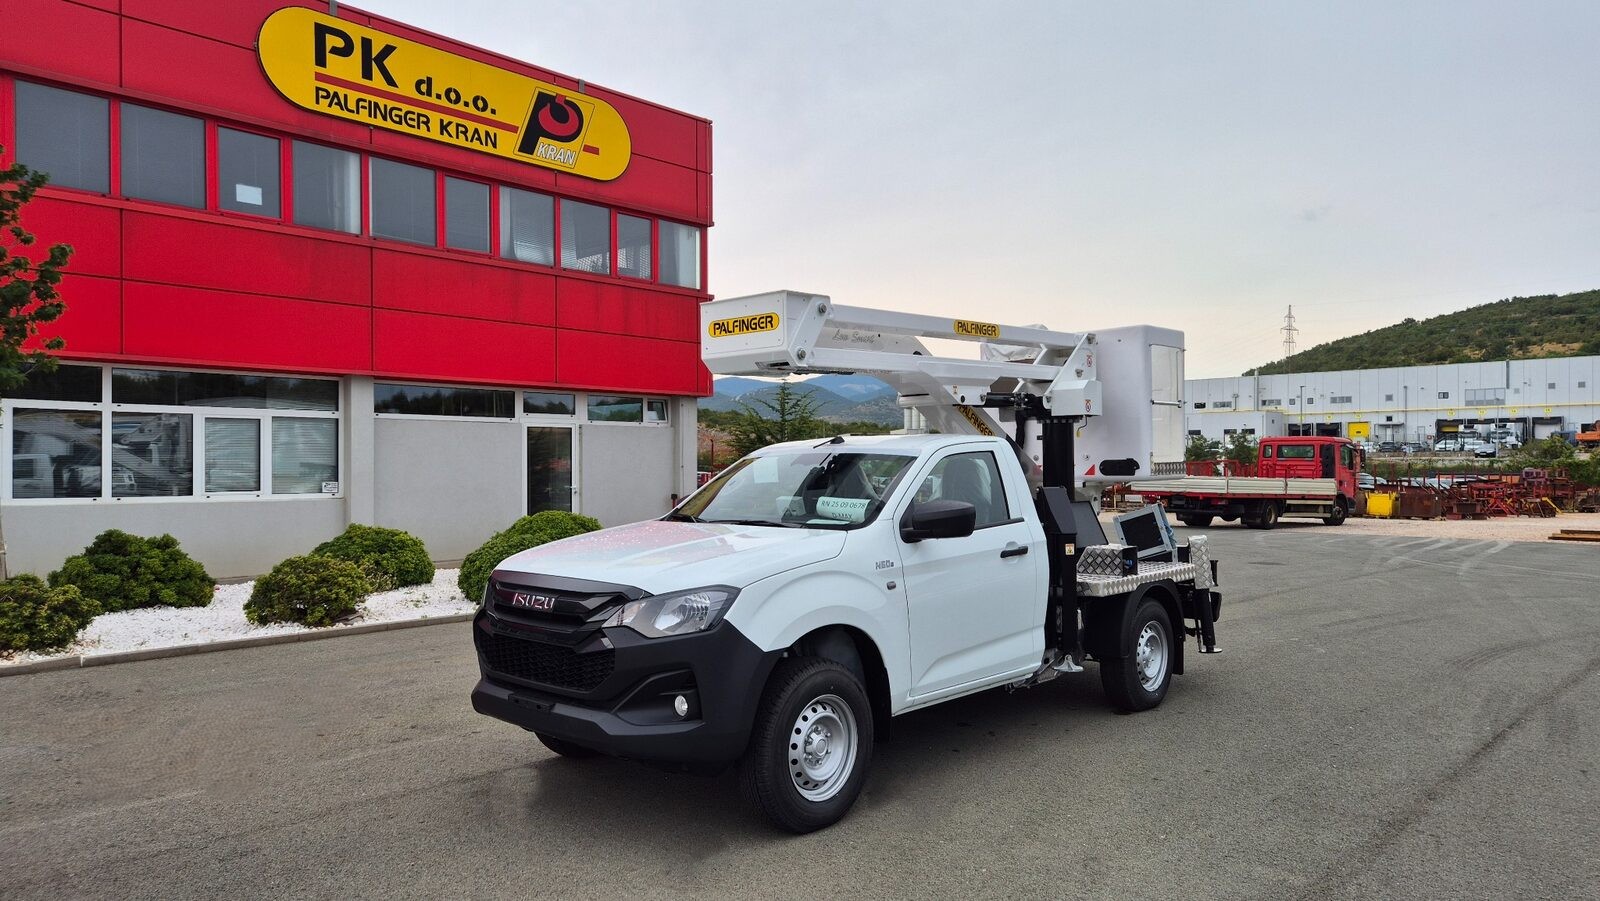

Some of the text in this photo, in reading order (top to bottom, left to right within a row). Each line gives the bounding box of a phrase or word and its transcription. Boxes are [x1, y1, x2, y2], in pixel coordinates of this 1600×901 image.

[314, 21, 497, 115] PK d.o.o.
[315, 86, 498, 149] PALFINGER KRAN
[537, 142, 577, 165] KRAN
[713, 315, 774, 335] PALFINGER
[957, 321, 997, 337] PALFINGER
[512, 592, 555, 609] ISUZU
